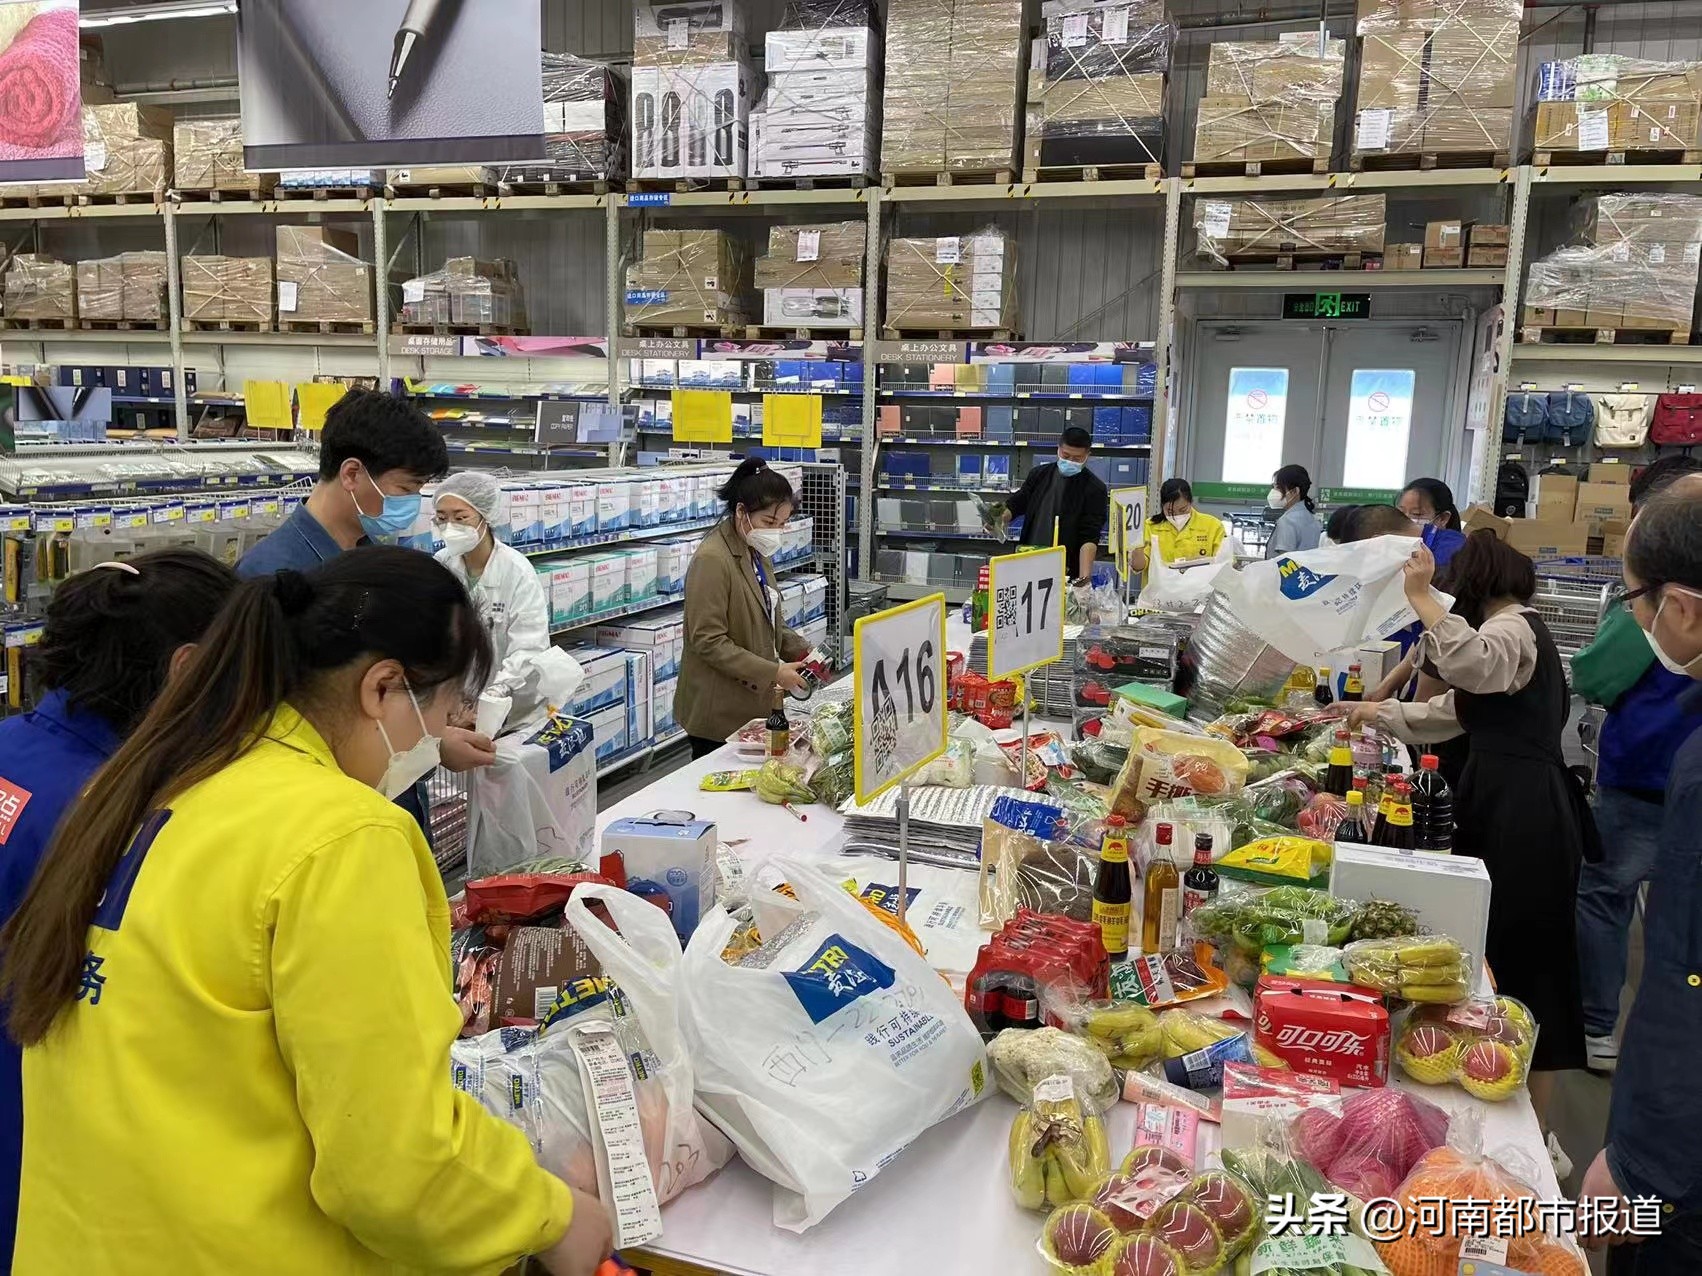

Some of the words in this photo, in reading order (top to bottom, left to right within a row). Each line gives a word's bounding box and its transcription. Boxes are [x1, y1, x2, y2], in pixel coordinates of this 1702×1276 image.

[1341, 302, 1360, 312] EXIT
[639, 340, 689, 349] 桌上办公文具
[901, 344, 957, 352] 桌上办公文具
[401, 347, 421, 355] DESK
[422, 347, 453, 355] STORAGE
[881, 353, 903, 361] DESK
[1126, 503, 1141, 530] 20
[1276, 1024, 1371, 1056] 可口可乐
